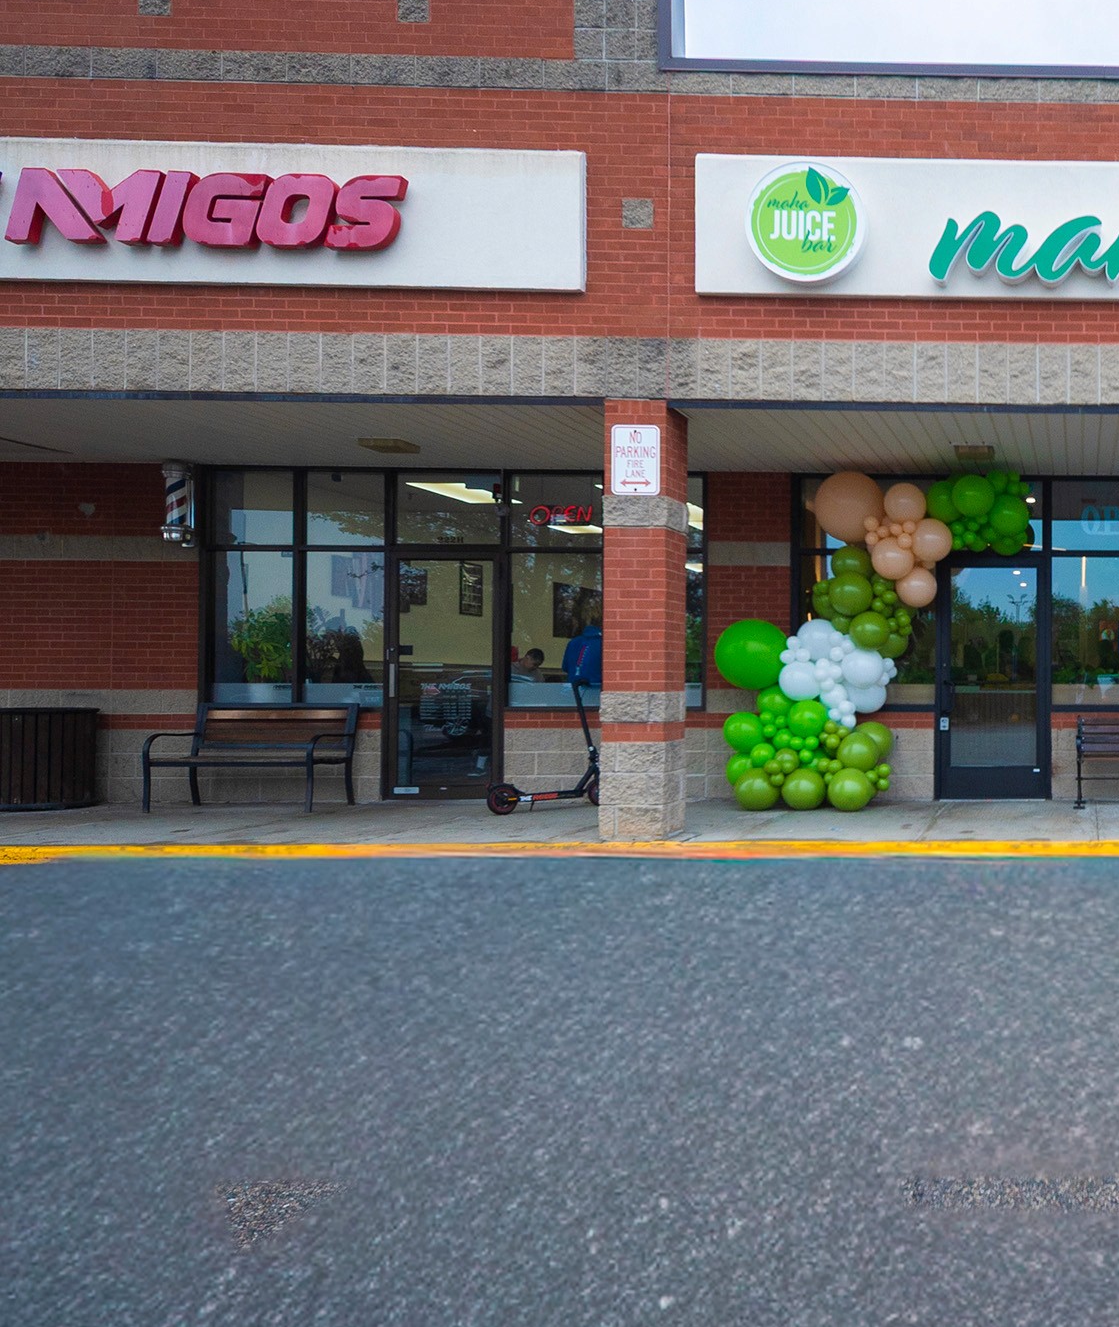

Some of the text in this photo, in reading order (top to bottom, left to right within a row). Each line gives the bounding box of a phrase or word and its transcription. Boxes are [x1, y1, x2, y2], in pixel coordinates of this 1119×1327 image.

[4, 167, 409, 252] AMIGOS
[767, 190, 810, 211] maha
[769, 209, 836, 241] JUICE
[801, 229, 837, 253] bar
[629, 431, 643, 444] NO
[615, 445, 657, 459] PARKING
[625, 469, 646, 479] LANE
[626, 459, 645, 469] FIRE
[530, 505, 593, 525] OPEN
